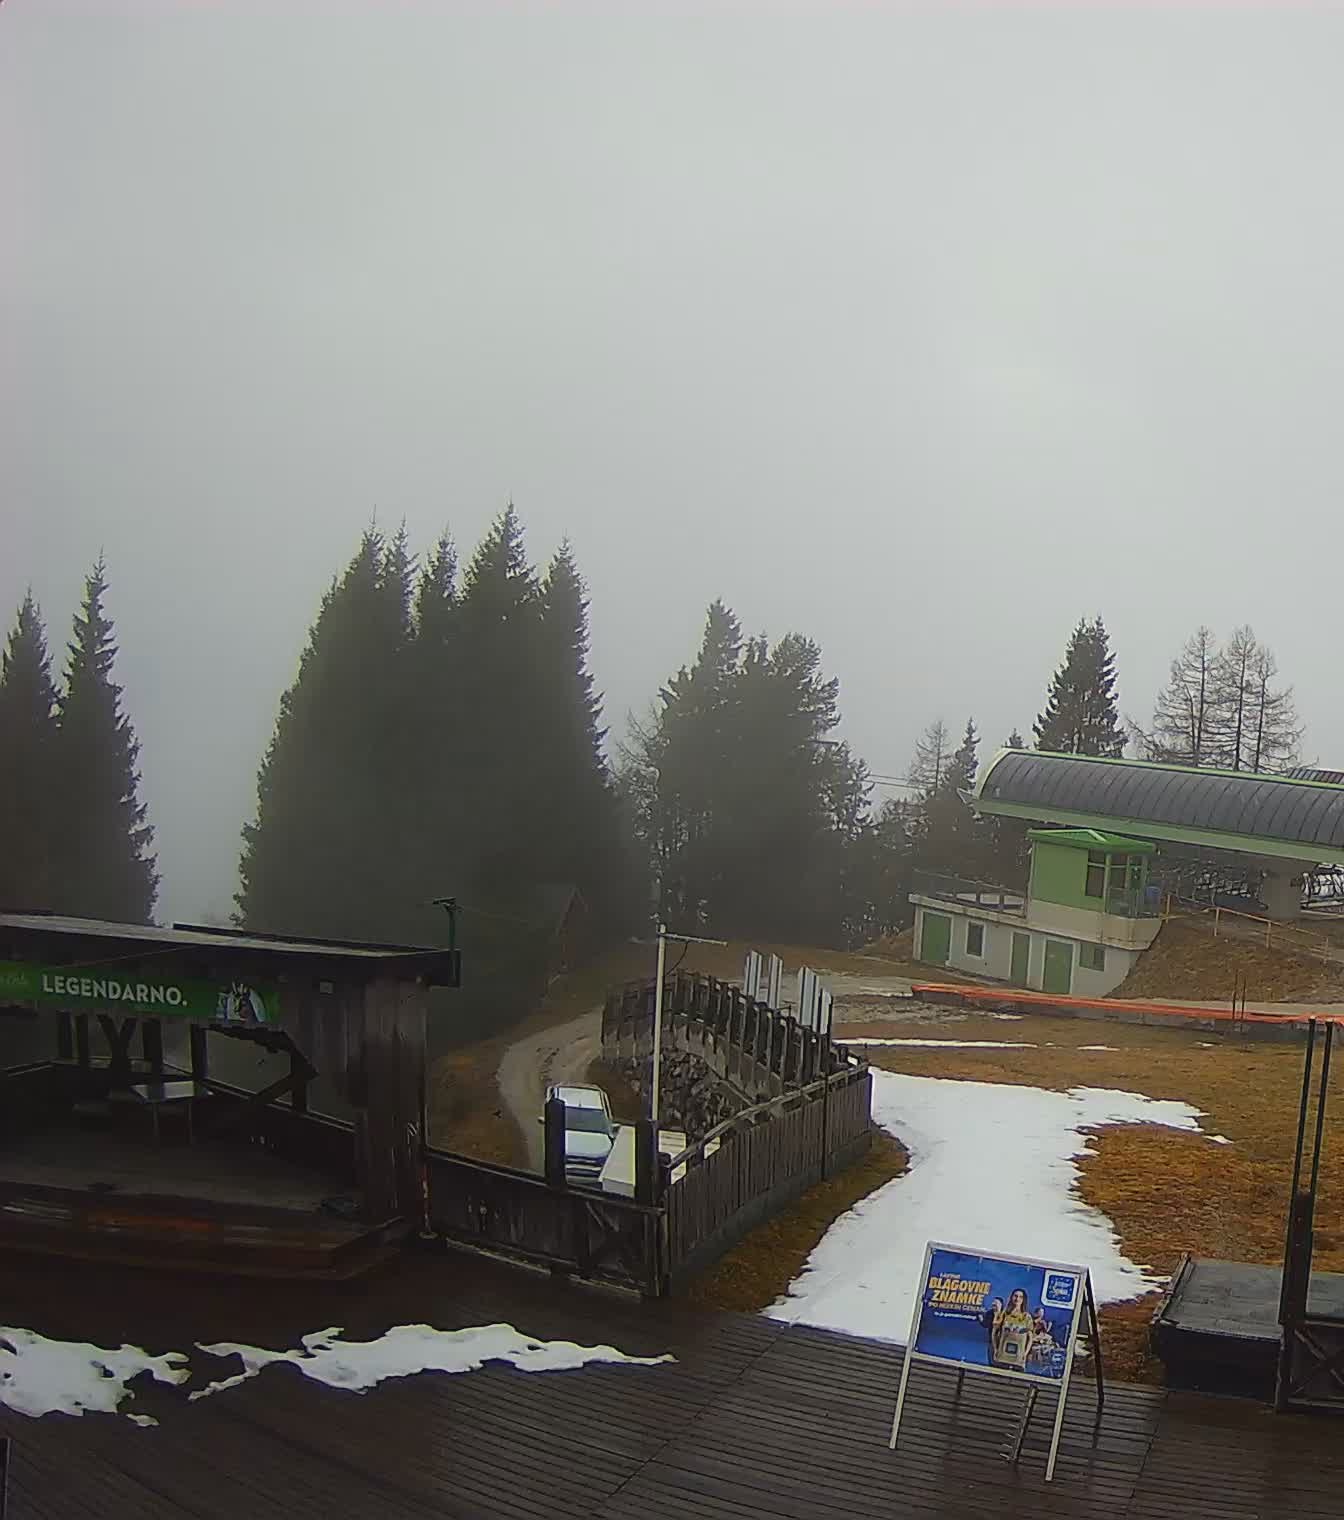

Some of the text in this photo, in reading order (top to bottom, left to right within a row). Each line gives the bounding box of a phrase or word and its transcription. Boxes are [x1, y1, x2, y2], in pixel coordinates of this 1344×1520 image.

[42, 974, 188, 1006] LEGENDARNO.
[928, 1276, 991, 1295] BLAGOVNE
[931, 1289, 985, 1305] ZNAMKE
